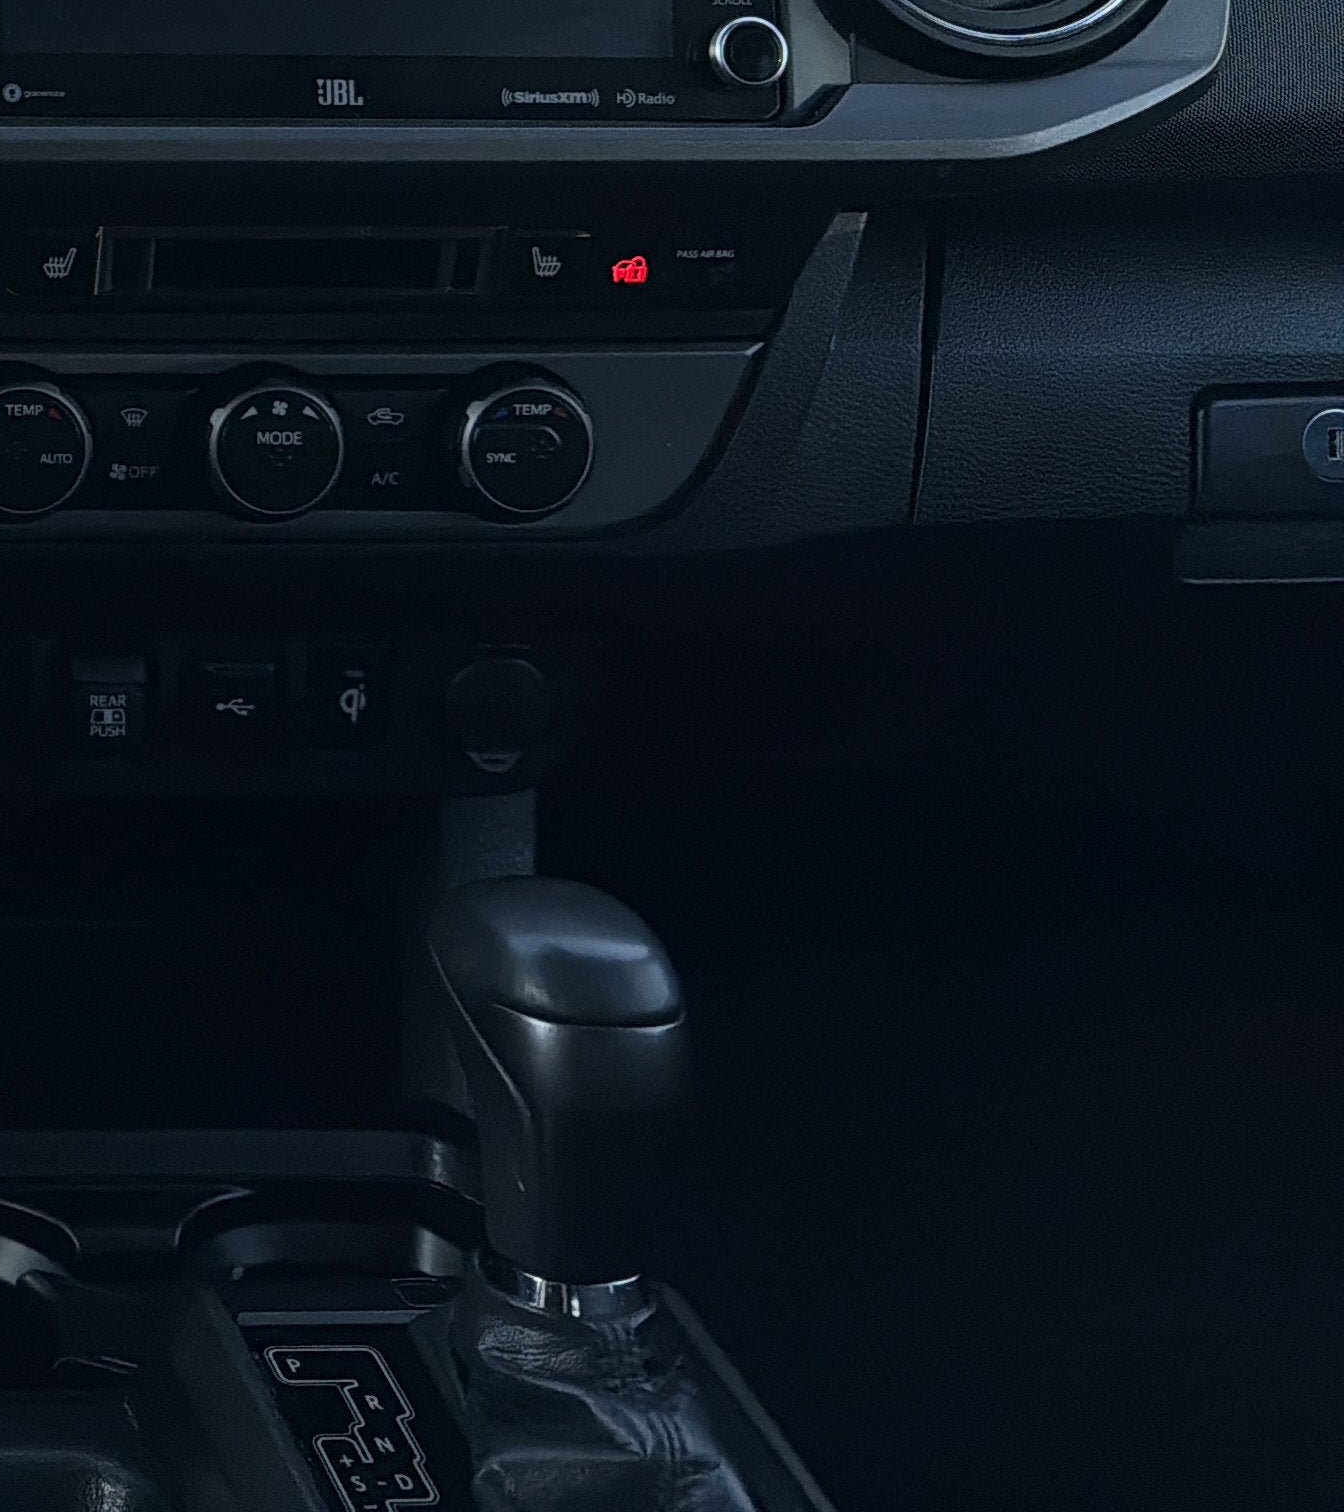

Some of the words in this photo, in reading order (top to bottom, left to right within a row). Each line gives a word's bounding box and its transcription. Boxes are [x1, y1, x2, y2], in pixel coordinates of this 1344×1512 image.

[316, 79, 364, 106] JBL
[638, 92, 676, 105] Radio
[5, 404, 44, 417] TEMP
[513, 403, 553, 416] TEMP
[257, 431, 304, 446] MODE
[40, 453, 73, 465] AUTO
[485, 452, 517, 464] SYNC
[128, 465, 159, 479] OFF
[371, 471, 401, 486] A/C
[89, 694, 127, 708] REAR
[89, 724, 126, 738] PUSH
[285, 1358, 301, 1373] P
[364, 1394, 384, 1411] R
[374, 1437, 396, 1453] N
[350, 1475, 367, 1492] S
[394, 1473, 414, 1491] D
